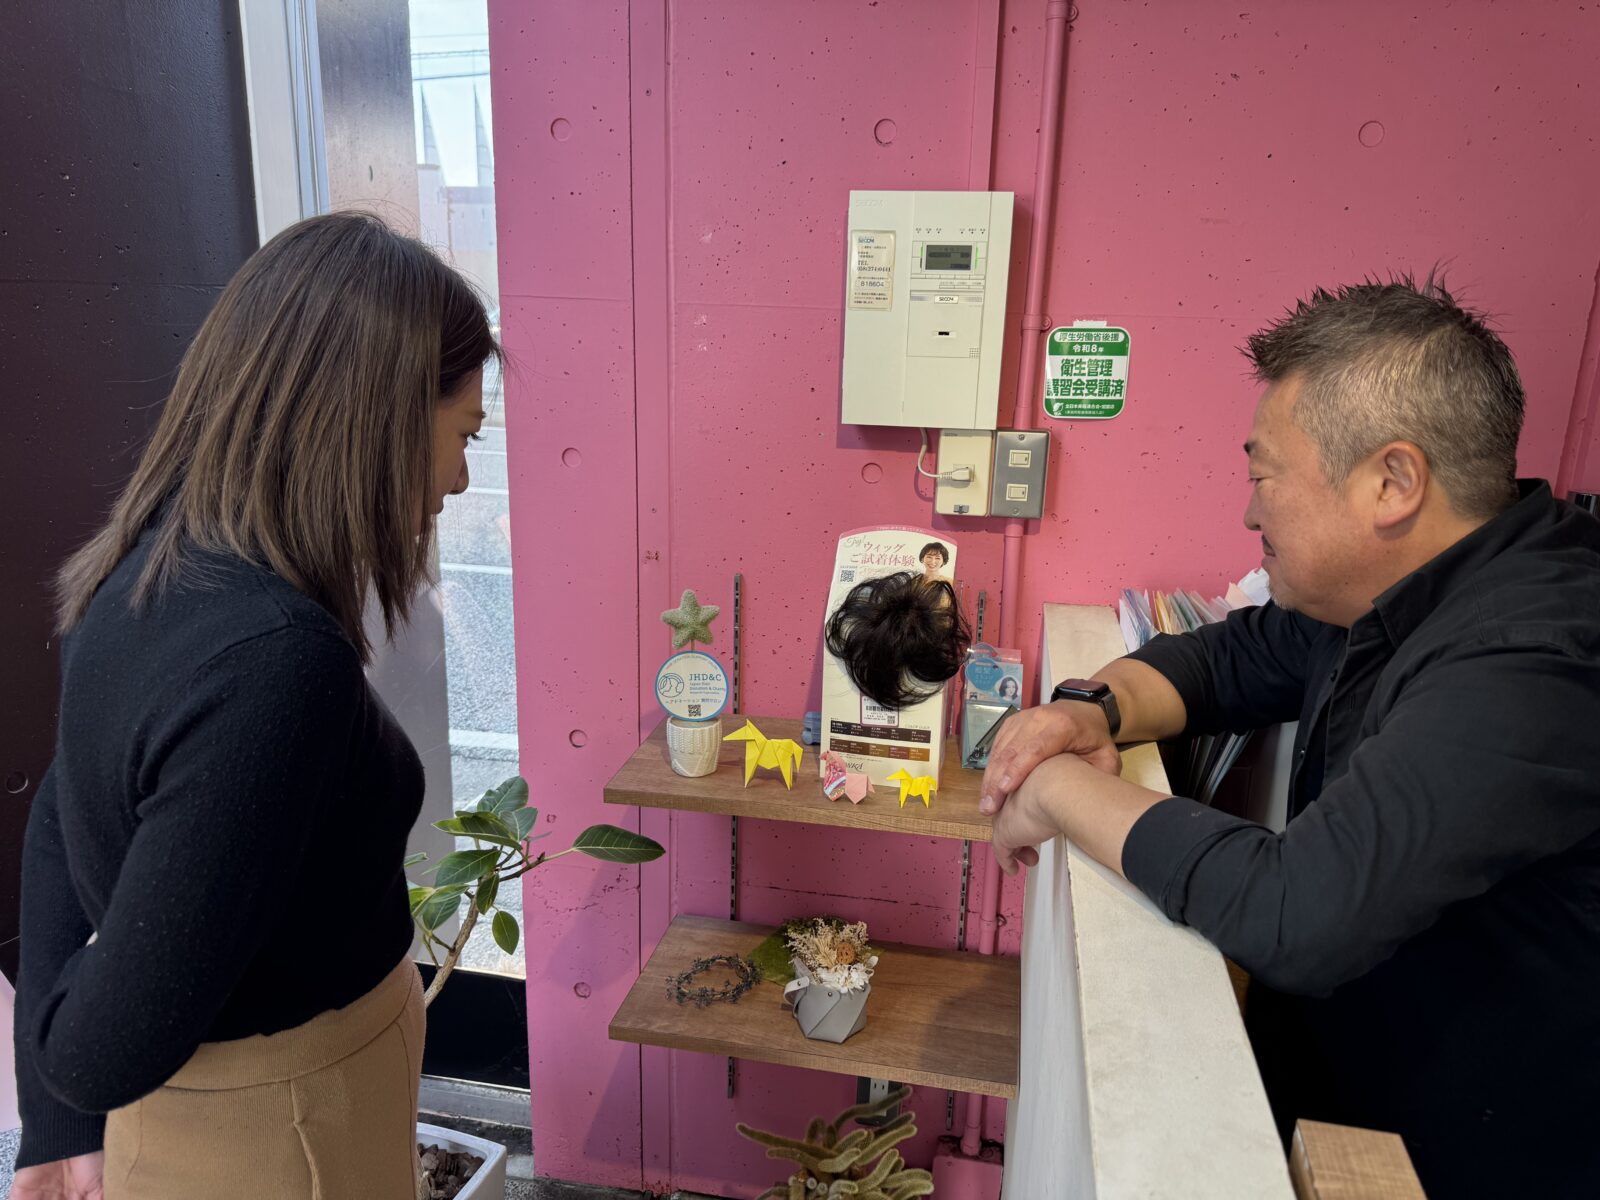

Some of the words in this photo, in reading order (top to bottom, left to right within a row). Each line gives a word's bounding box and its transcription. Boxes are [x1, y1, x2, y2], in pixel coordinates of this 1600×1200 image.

[1059, 332, 1120, 342] 厚生労働省後援
[1072, 344, 1105, 353] 令和8年
[1060, 358, 1114, 377] 衛生管理
[1046, 378, 1125, 397] 講習会受講済
[863, 541, 906, 554] ウィッグ
[850, 553, 916, 567] ご試着体験
[689, 673, 722, 681] JHD&C
